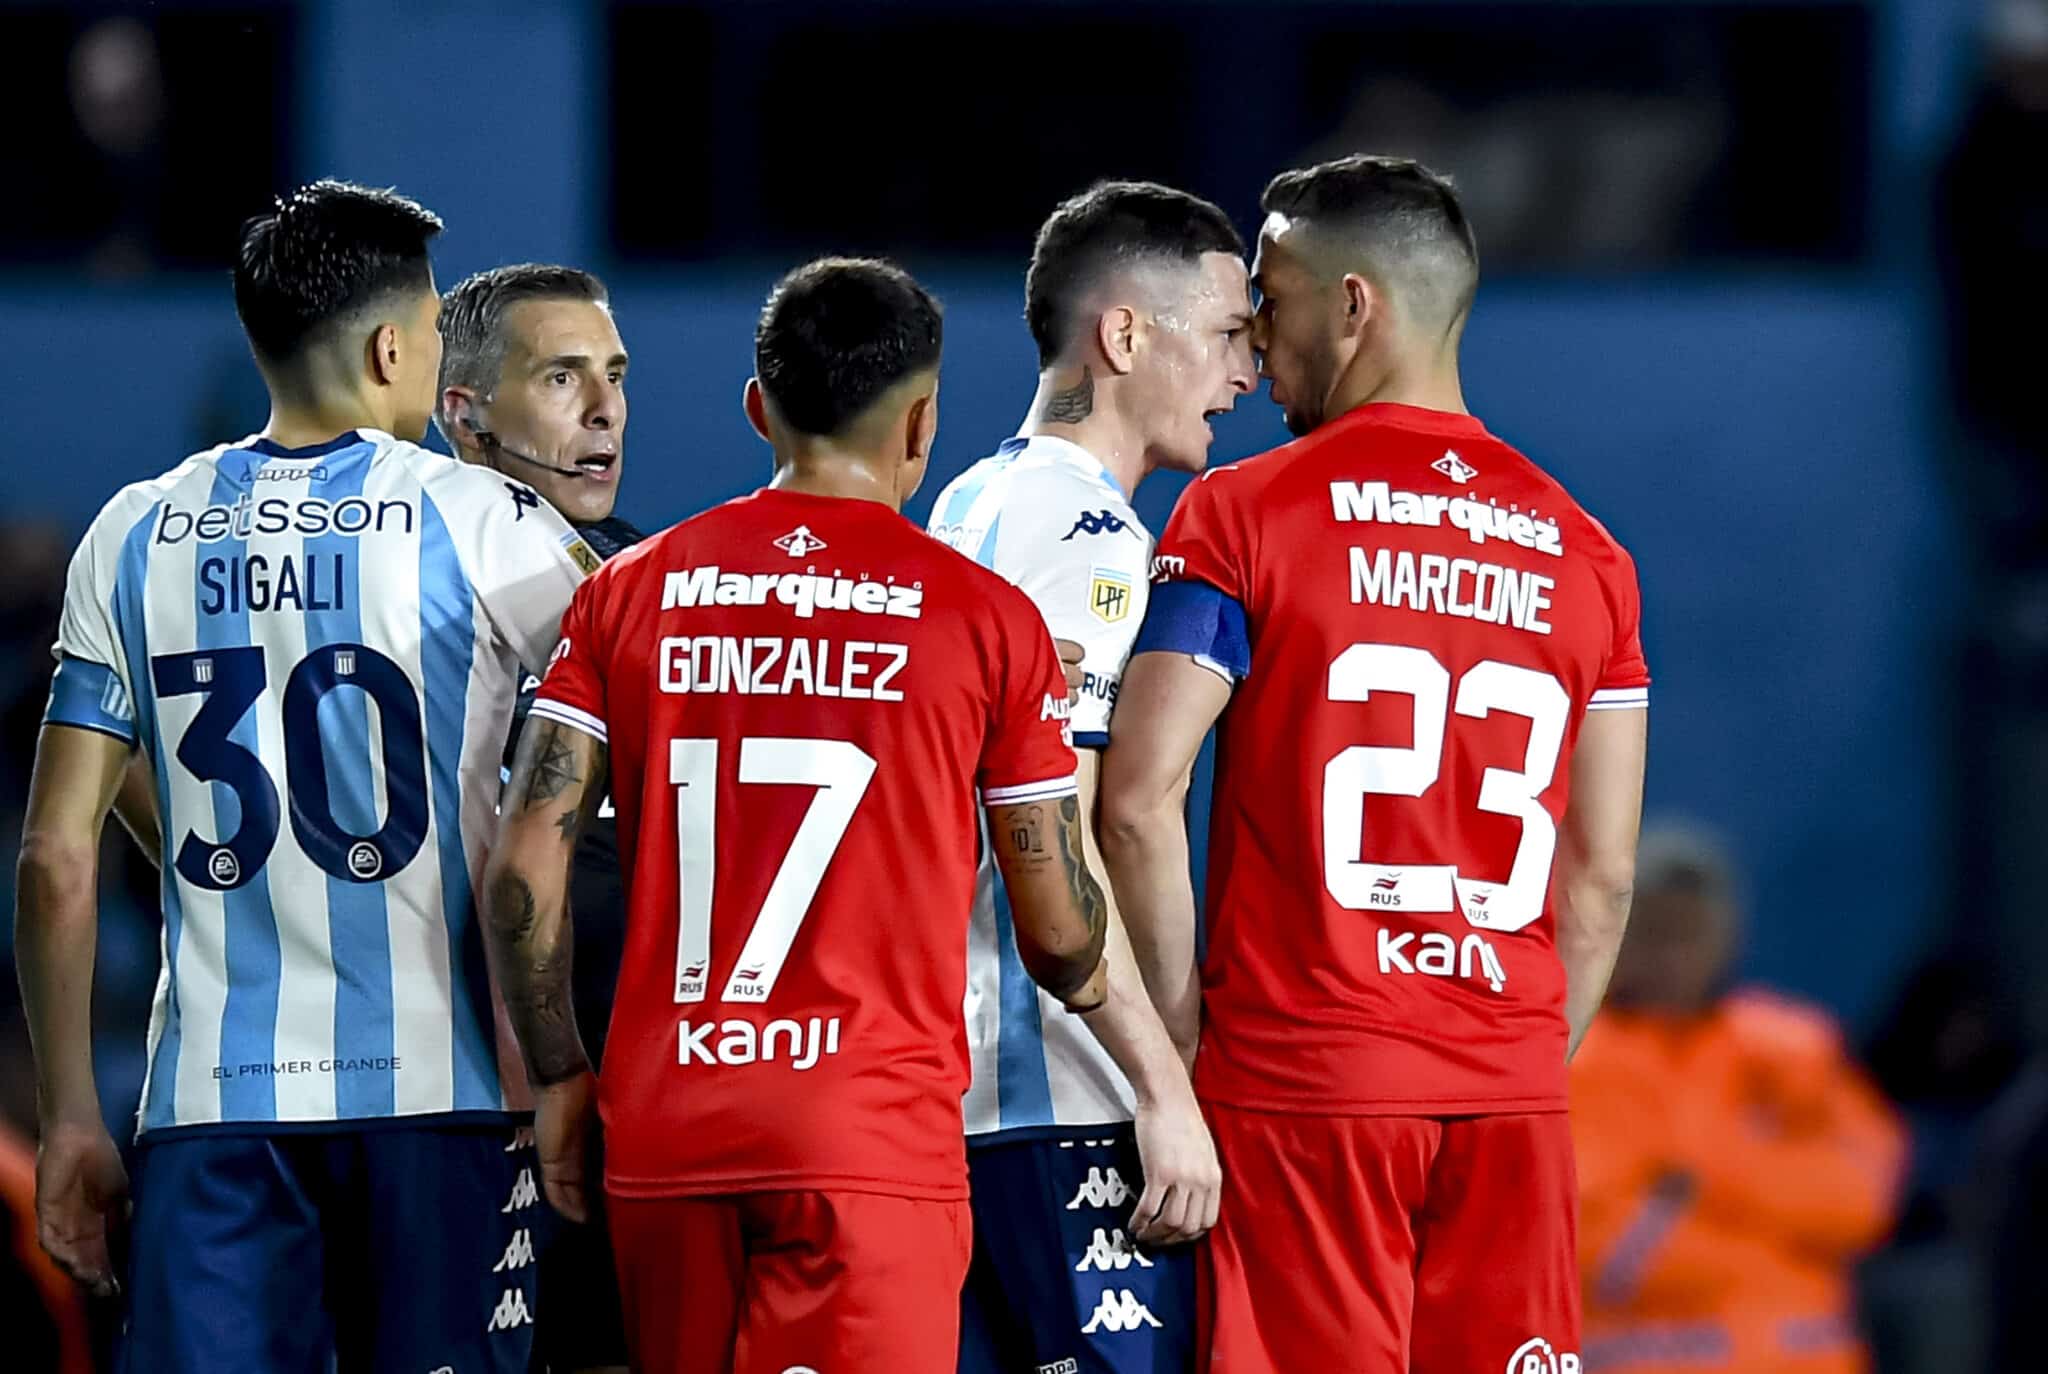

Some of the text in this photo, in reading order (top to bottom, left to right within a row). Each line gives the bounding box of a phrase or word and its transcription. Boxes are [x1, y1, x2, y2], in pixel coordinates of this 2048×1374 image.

[156, 493, 413, 545] betsson
[1329, 481, 1564, 557] Marquez
[200, 552, 343, 615] SIGALI
[661, 566, 923, 619] Marquez
[1349, 546, 1555, 635] MARCONE
[659, 636, 908, 701] GONZALEZ
[151, 642, 429, 890] 30
[1322, 642, 1571, 933] 23
[669, 738, 878, 1003] 17
[1370, 892, 1401, 905] RUS
[733, 984, 765, 996] RUS
[212, 1056, 401, 1079] EL PRIMER GRANDE
